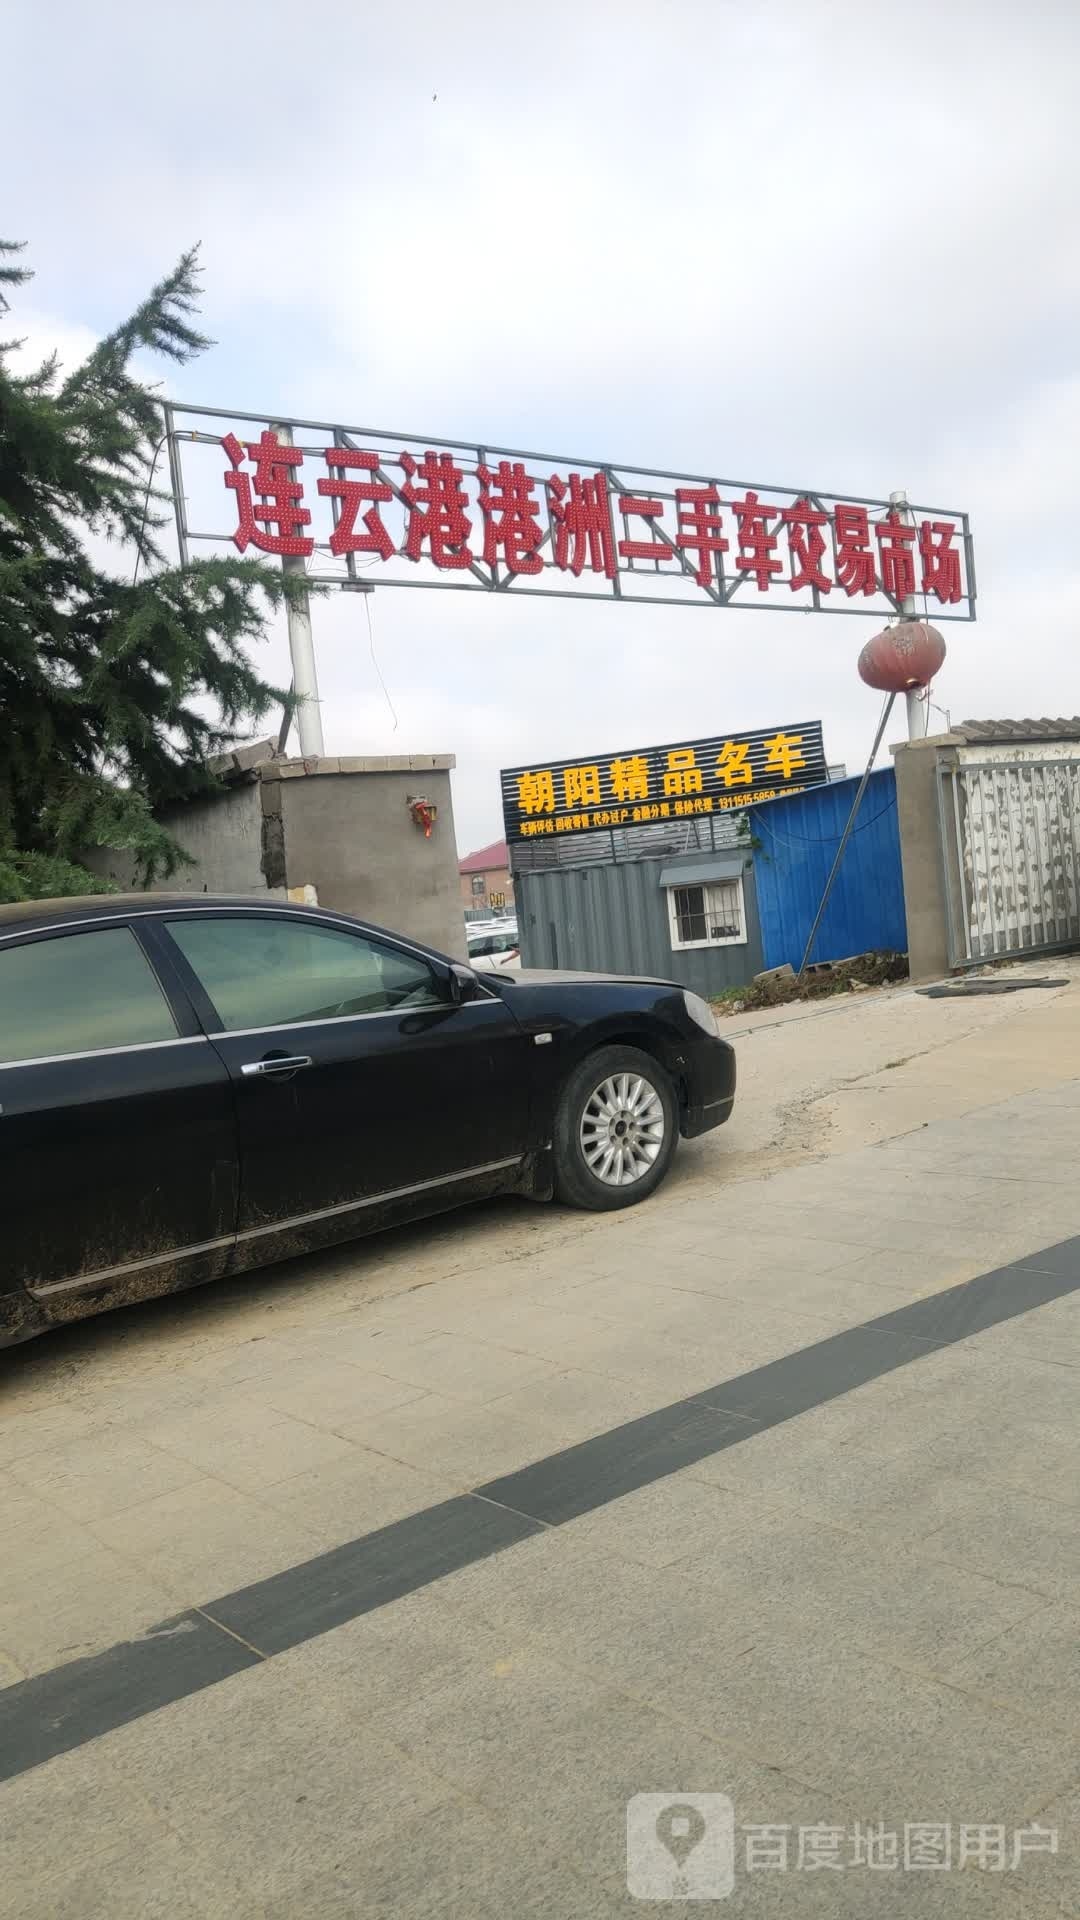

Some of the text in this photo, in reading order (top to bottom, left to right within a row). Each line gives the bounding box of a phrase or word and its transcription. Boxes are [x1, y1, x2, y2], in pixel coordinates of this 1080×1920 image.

[222, 431, 962, 603] 连云港港洲二手车交易市场
[516, 734, 806, 814] 朝阳精品名车
[593, 808, 628, 825] 代办过户
[632, 803, 670, 821] 金融分期
[674, 797, 712, 815] 保险代理
